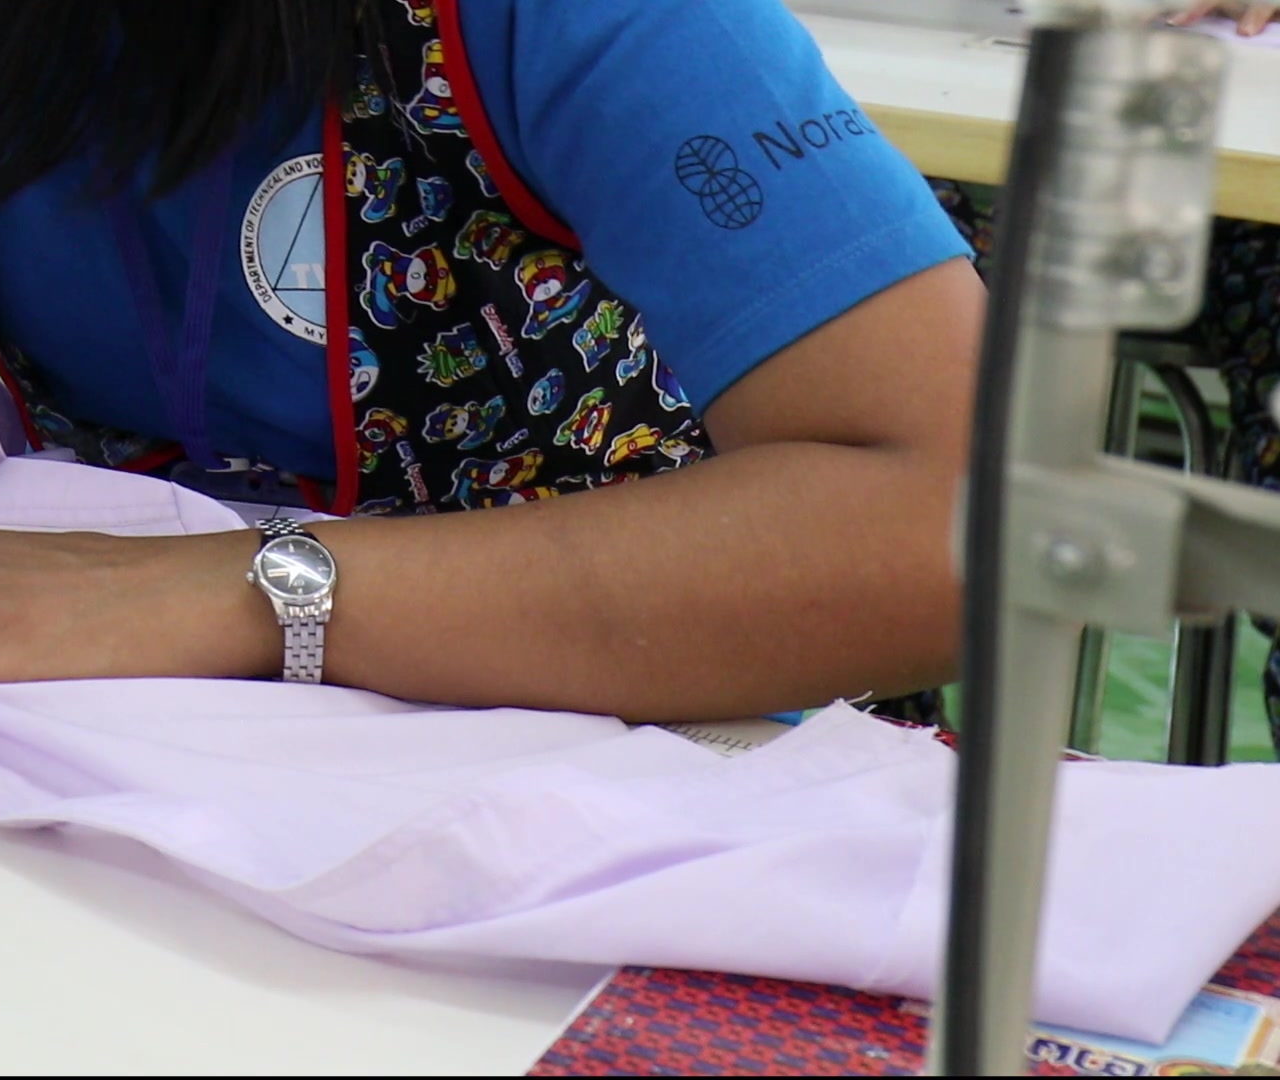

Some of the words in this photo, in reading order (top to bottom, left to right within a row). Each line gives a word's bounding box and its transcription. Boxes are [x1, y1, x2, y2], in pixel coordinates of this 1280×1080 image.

[282, 161, 304, 177] AND
[249, 173, 283, 218] TECHNICAL
[244, 219, 255, 234] OF
[244, 236, 273, 304] DEPARTMENT
